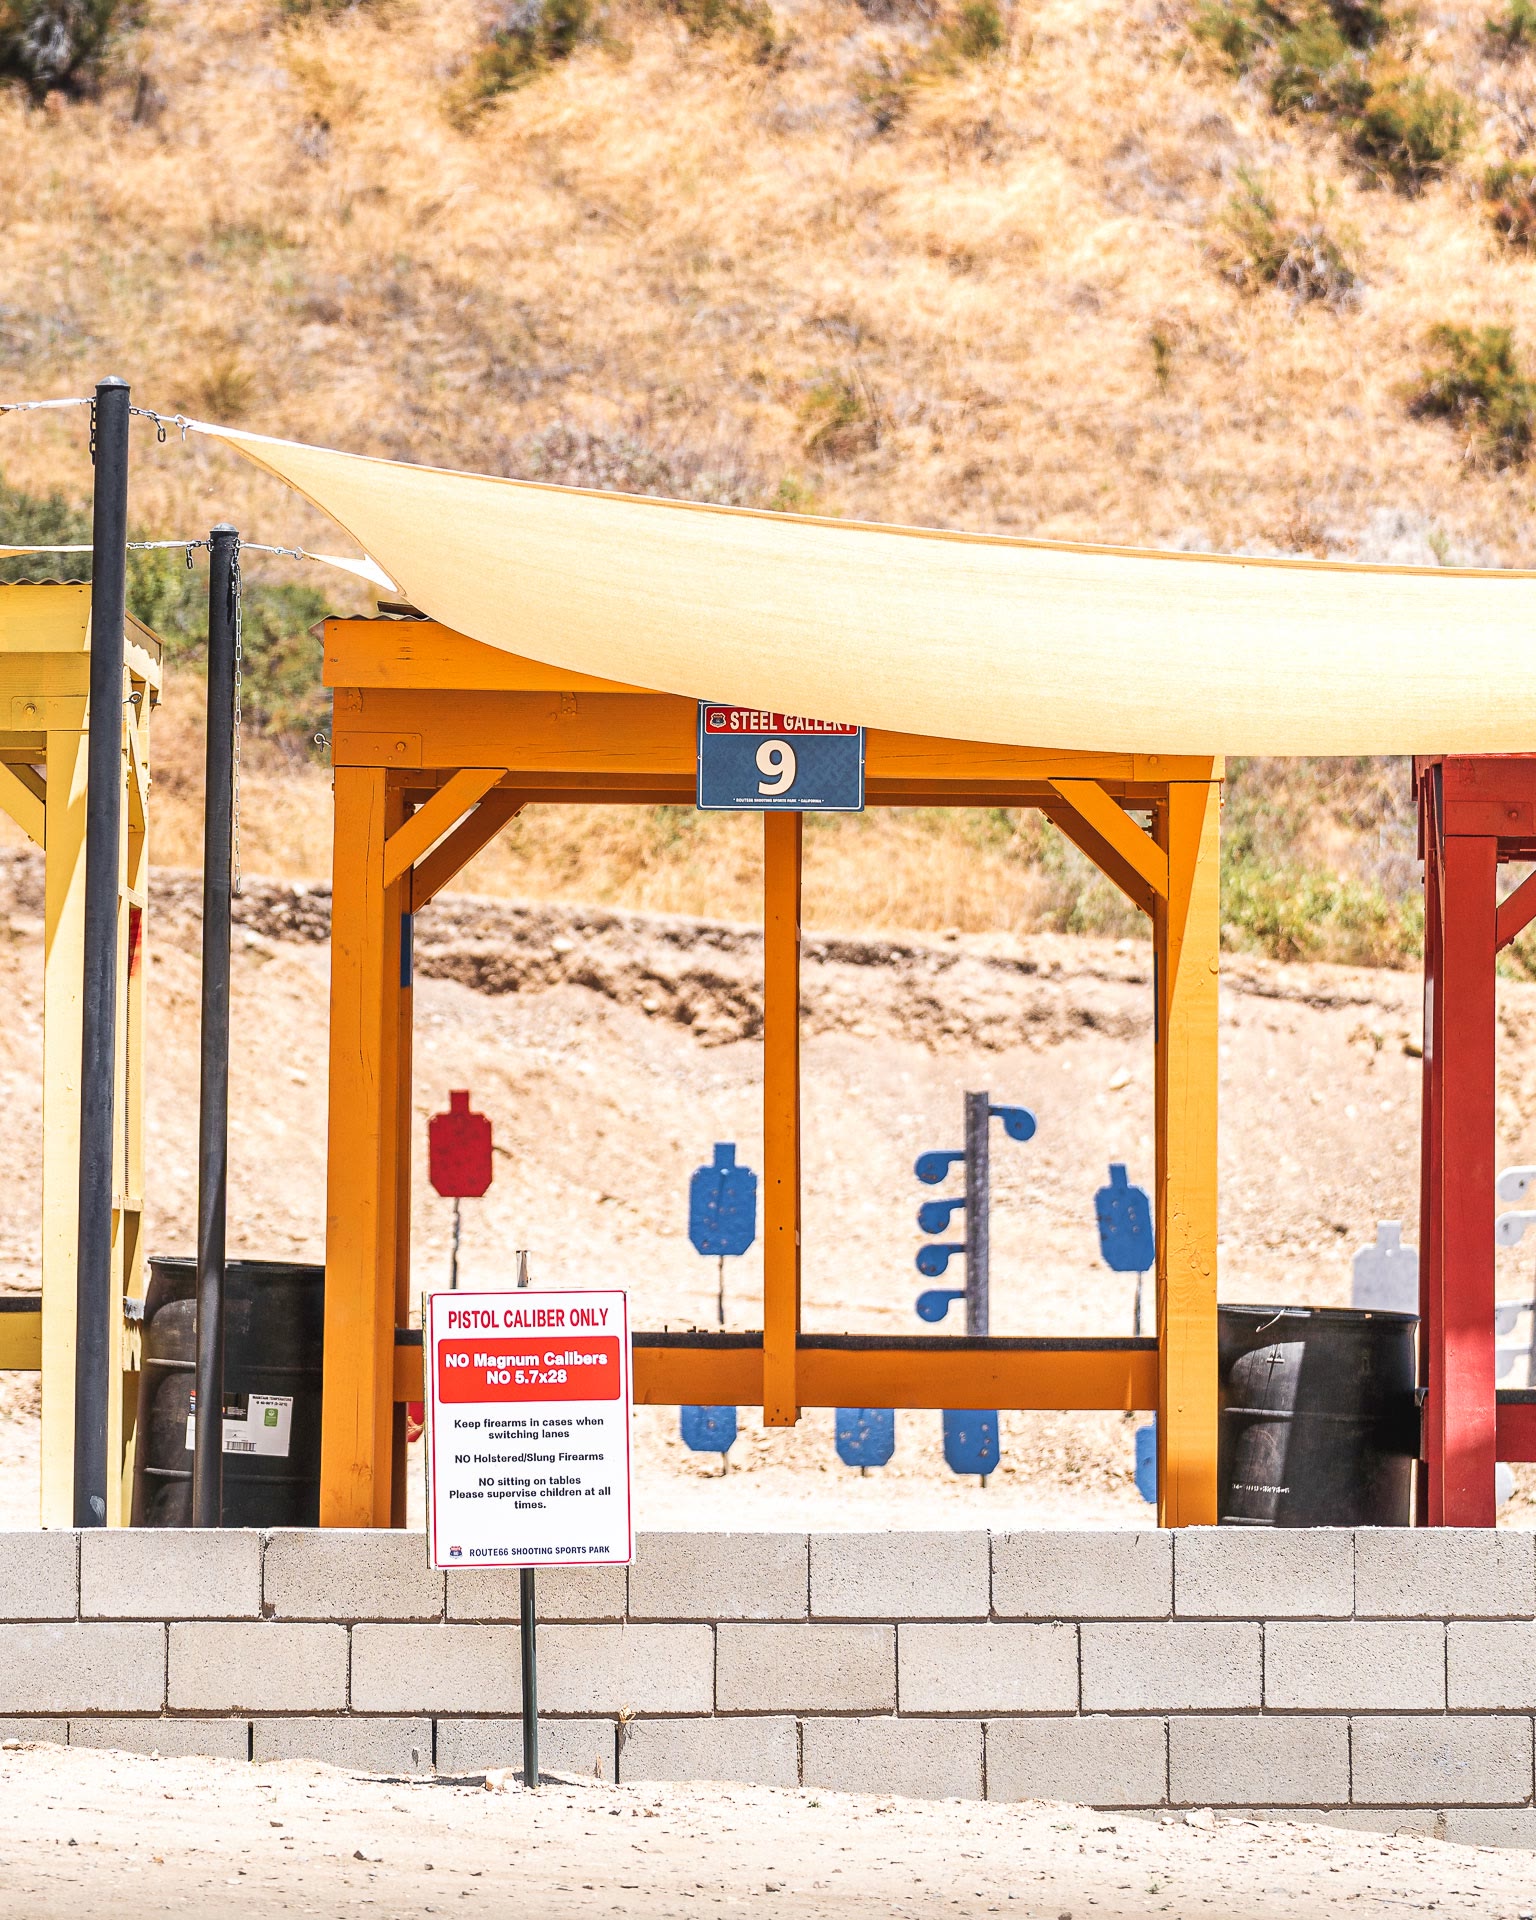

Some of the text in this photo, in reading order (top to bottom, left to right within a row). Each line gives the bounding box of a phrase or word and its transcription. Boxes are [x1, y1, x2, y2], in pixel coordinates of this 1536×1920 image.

[730, 711, 778, 730] STEEL
[755, 739, 796, 796] 9
[448, 1307, 609, 1329] PISTOL CALIBER ONLY
[445, 1350, 608, 1370] NO Magnum Calibers
[486, 1368, 568, 1385] NO 5.7x28
[454, 1420, 481, 1430] Keep
[483, 1419, 527, 1428] firearms
[529, 1418, 540, 1427] in
[575, 1417, 604, 1426] when
[488, 1430, 570, 1441] switching lanes
[454, 1453, 604, 1464] NO Holstered/Slung Firearms
[478, 1478, 495, 1487] NO
[497, 1477, 531, 1488] sitting
[549, 1476, 582, 1485] tables
[449, 1487, 611, 1499] Please supervise children at all
[514, 1501, 547, 1510] times.
[469, 1546, 610, 1557] ROUTE66 SHOOTING SPORTS PARK
